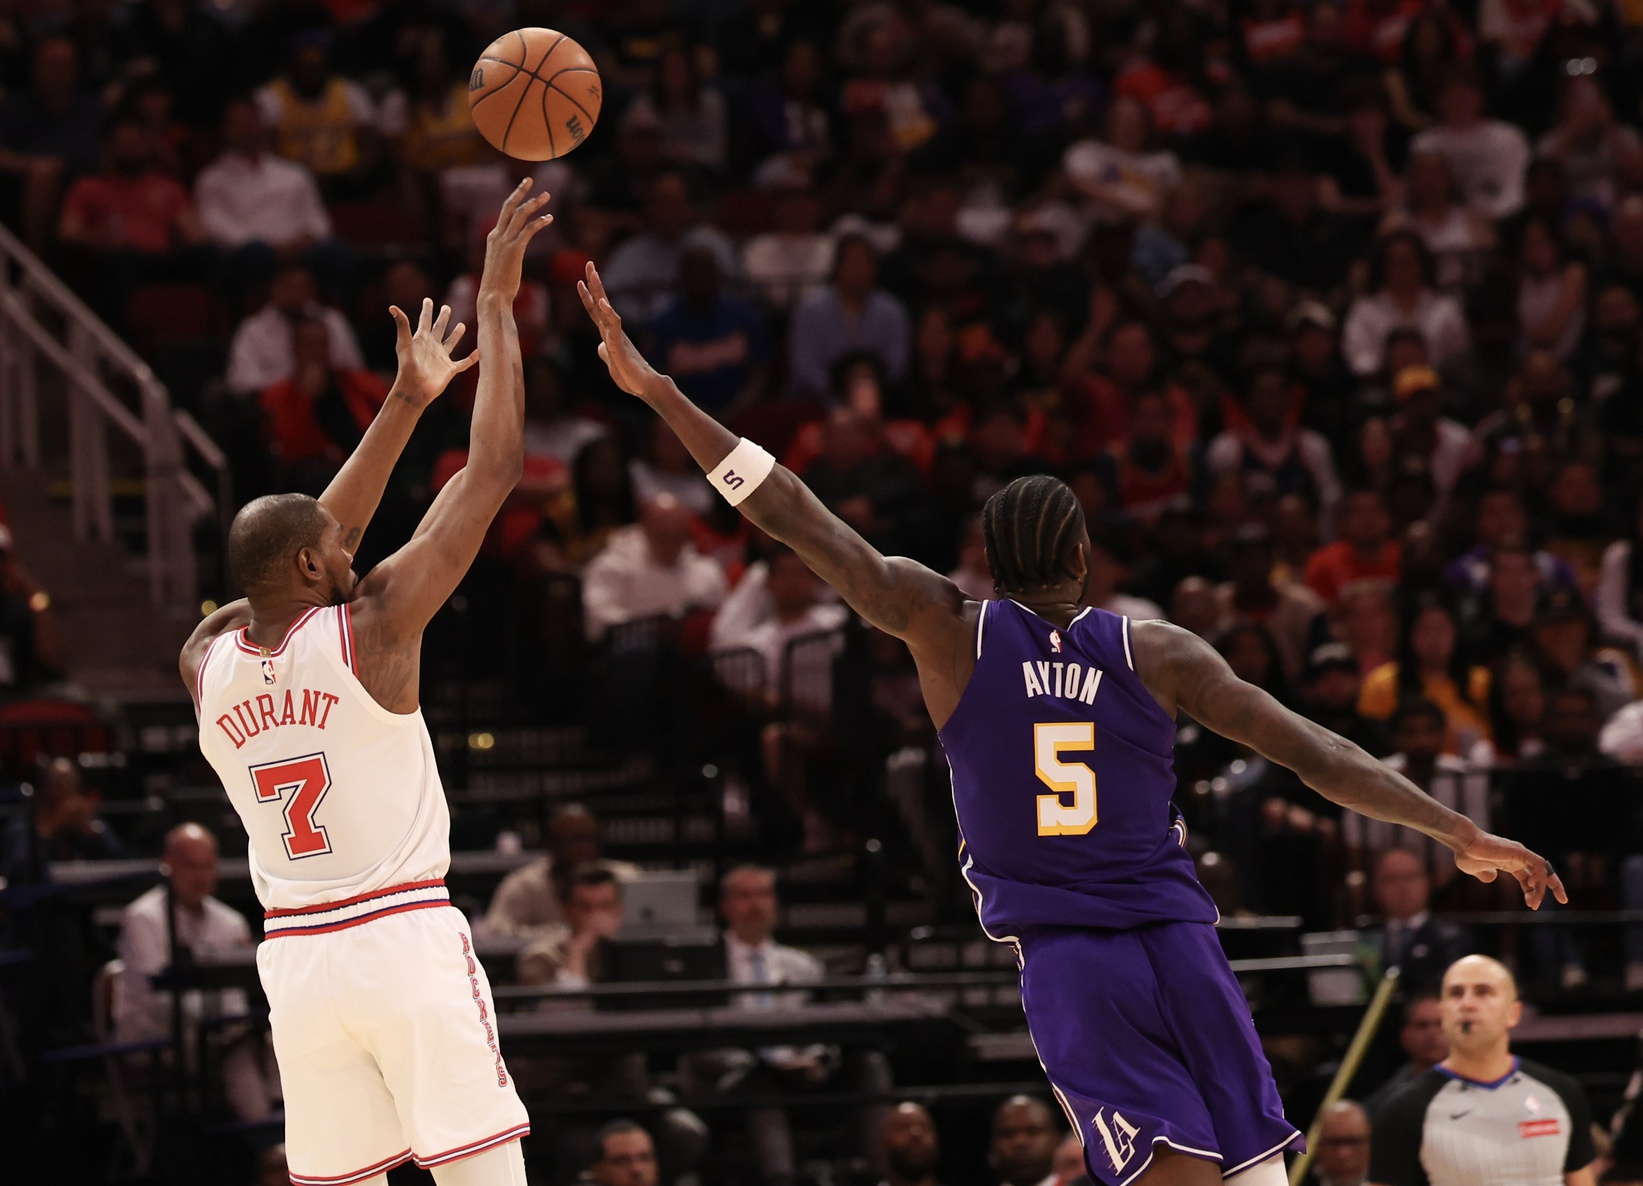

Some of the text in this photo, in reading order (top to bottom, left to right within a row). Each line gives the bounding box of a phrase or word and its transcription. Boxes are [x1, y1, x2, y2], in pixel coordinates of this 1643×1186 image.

[723, 469, 744, 490] 5
[1022, 660, 1103, 705] AYTON
[216, 689, 339, 749] DURANT
[248, 751, 332, 861] 7
[1034, 722, 1099, 836] 5
[1091, 1106, 1141, 1176] LA
